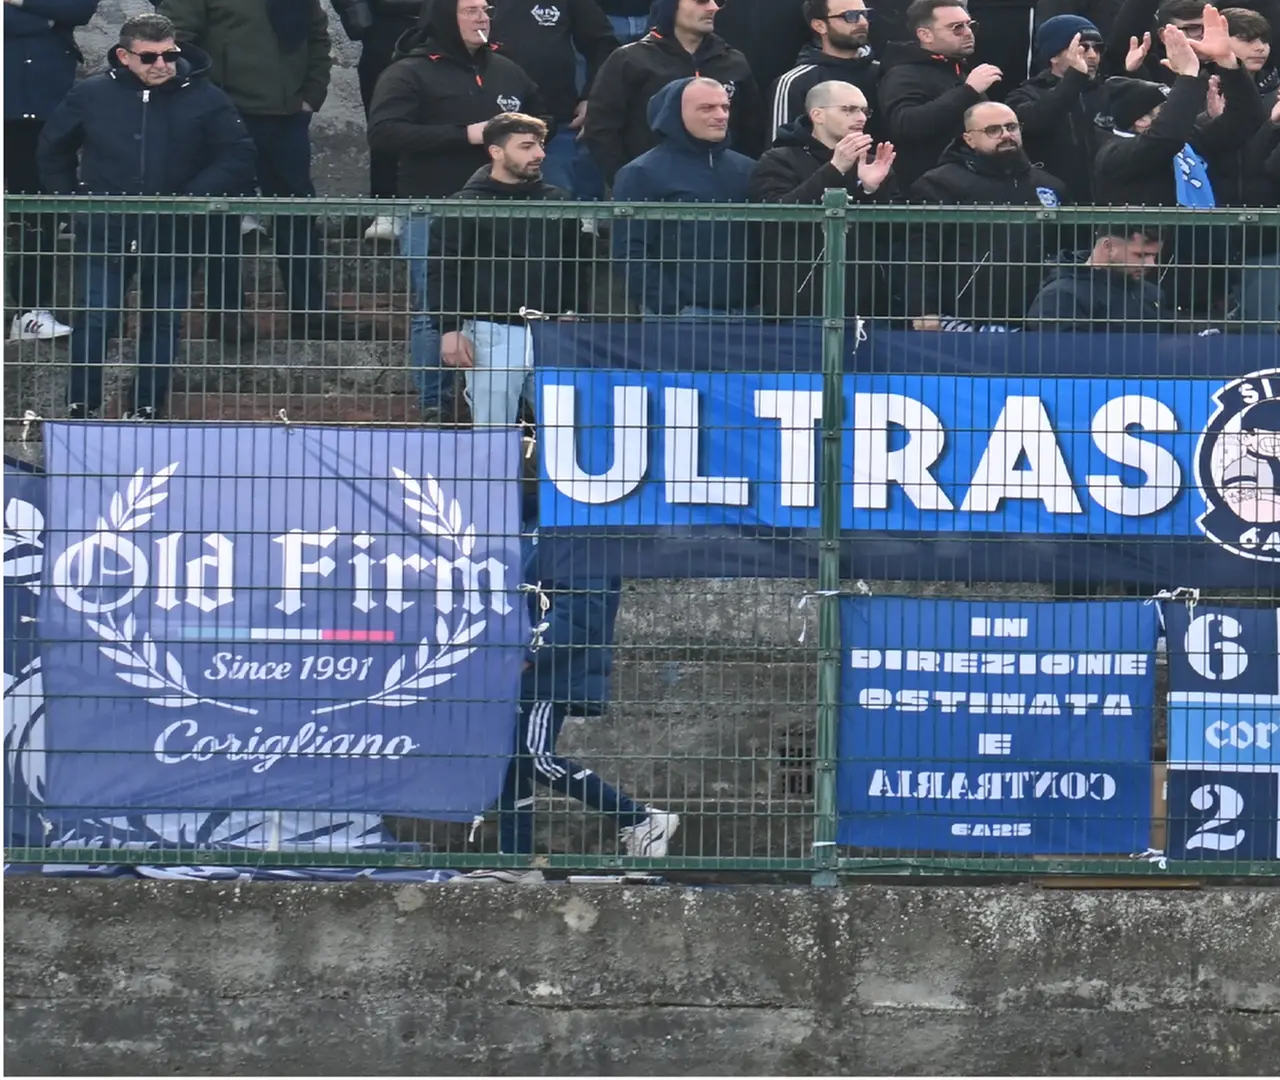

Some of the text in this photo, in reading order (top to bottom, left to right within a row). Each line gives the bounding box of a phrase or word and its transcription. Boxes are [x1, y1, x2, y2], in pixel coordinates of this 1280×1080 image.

[542, 383, 1182, 518] ULTRAS
[53, 526, 514, 617] Old Firm
[970, 616, 1029, 638] IN
[850, 649, 1149, 676] DIREZIONE
[1183, 612, 1249, 681] 6
[204, 650, 374, 682] Since 1991
[858, 687, 1134, 716] OSTINATA
[153, 718, 421, 773] Corigliano
[978, 732, 1013, 755] E
[951, 822, 1032, 837] 6A25
[1185, 783, 1246, 851] 2
